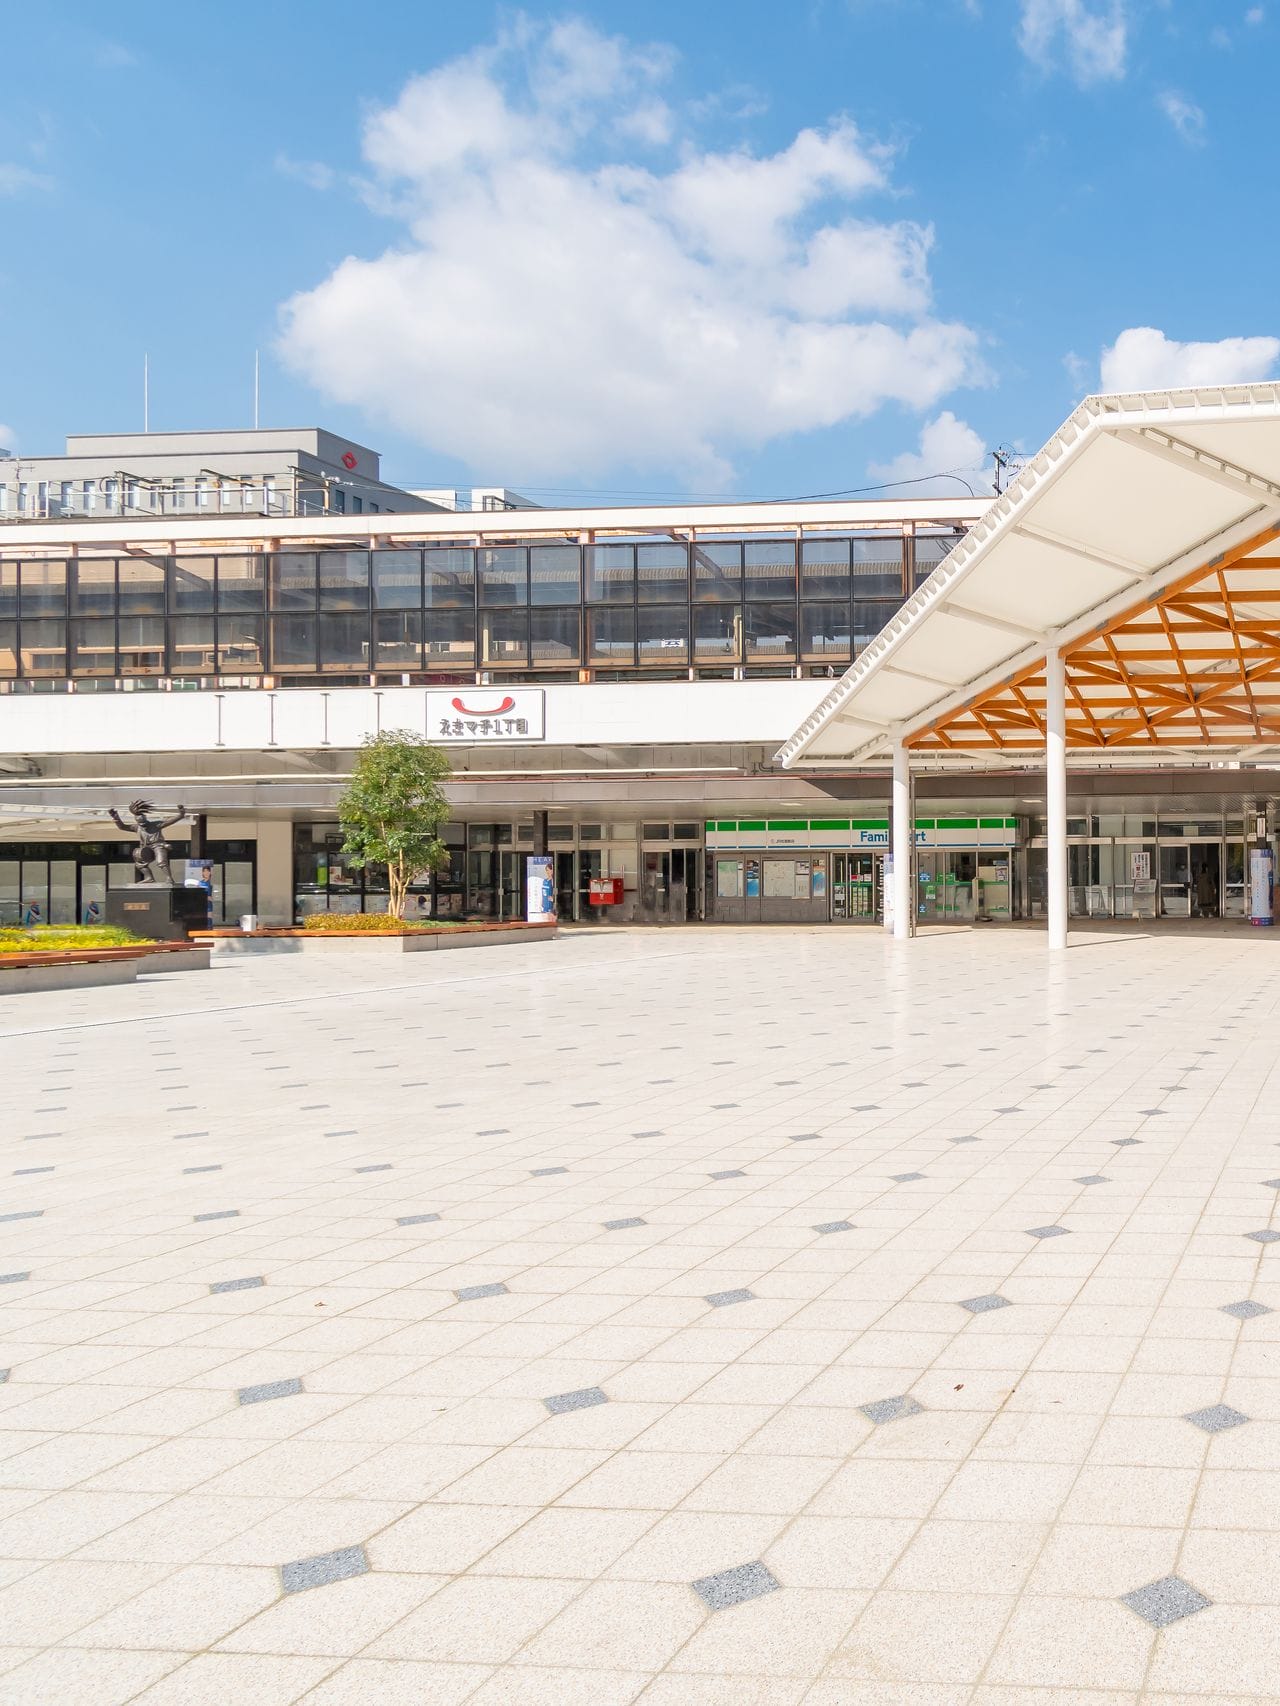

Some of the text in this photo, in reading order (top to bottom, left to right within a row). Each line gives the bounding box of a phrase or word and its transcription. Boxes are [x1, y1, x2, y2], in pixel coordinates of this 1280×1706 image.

[440, 718, 528, 736] えきマチ1丁目
[860, 831, 926, 842] Famiart
